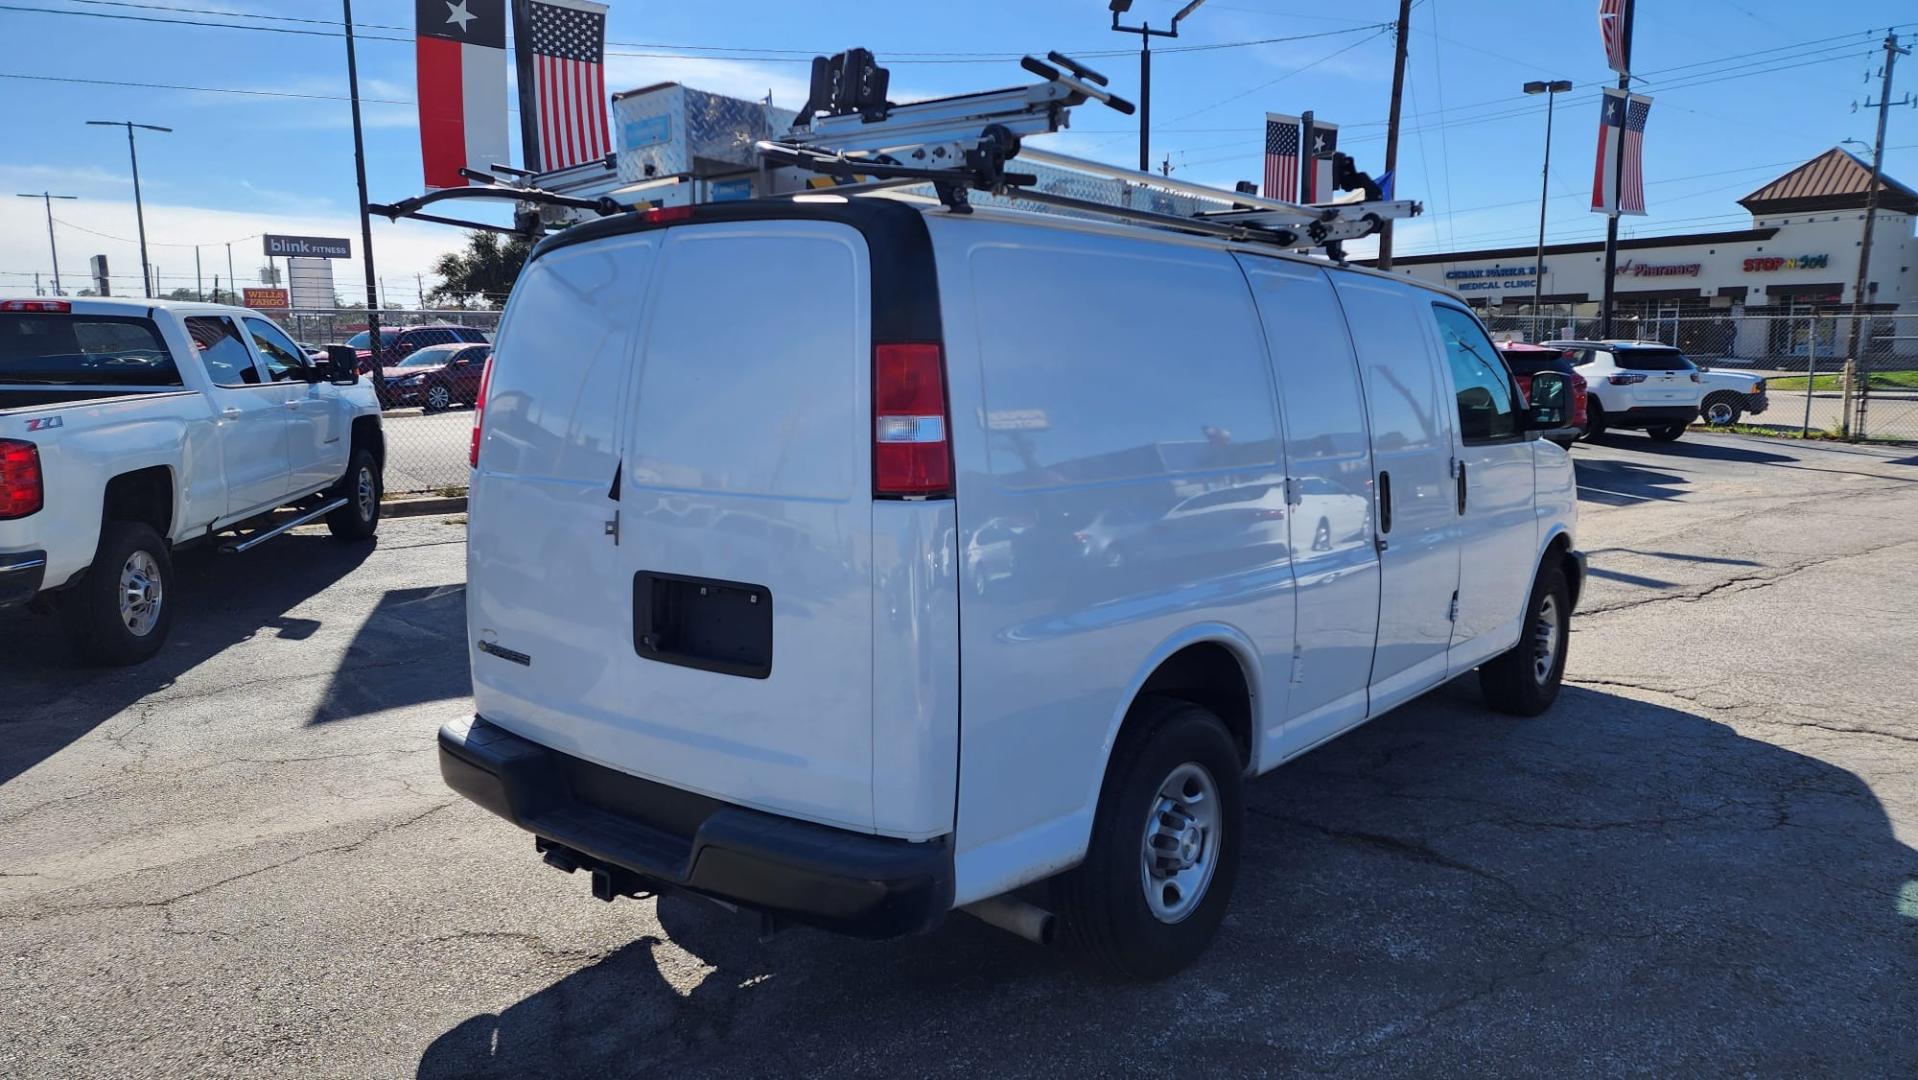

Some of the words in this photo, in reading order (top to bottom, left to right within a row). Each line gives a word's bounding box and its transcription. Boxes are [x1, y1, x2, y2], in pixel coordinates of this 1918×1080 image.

[270, 239, 310, 253] blink
[312, 246, 347, 254] FITNESS
[1633, 263, 1701, 277] Pharmacy
[1743, 257, 1785, 272] STOP
[1459, 280, 1501, 290] MEDICAL
[1504, 280, 1537, 288] CLINIC
